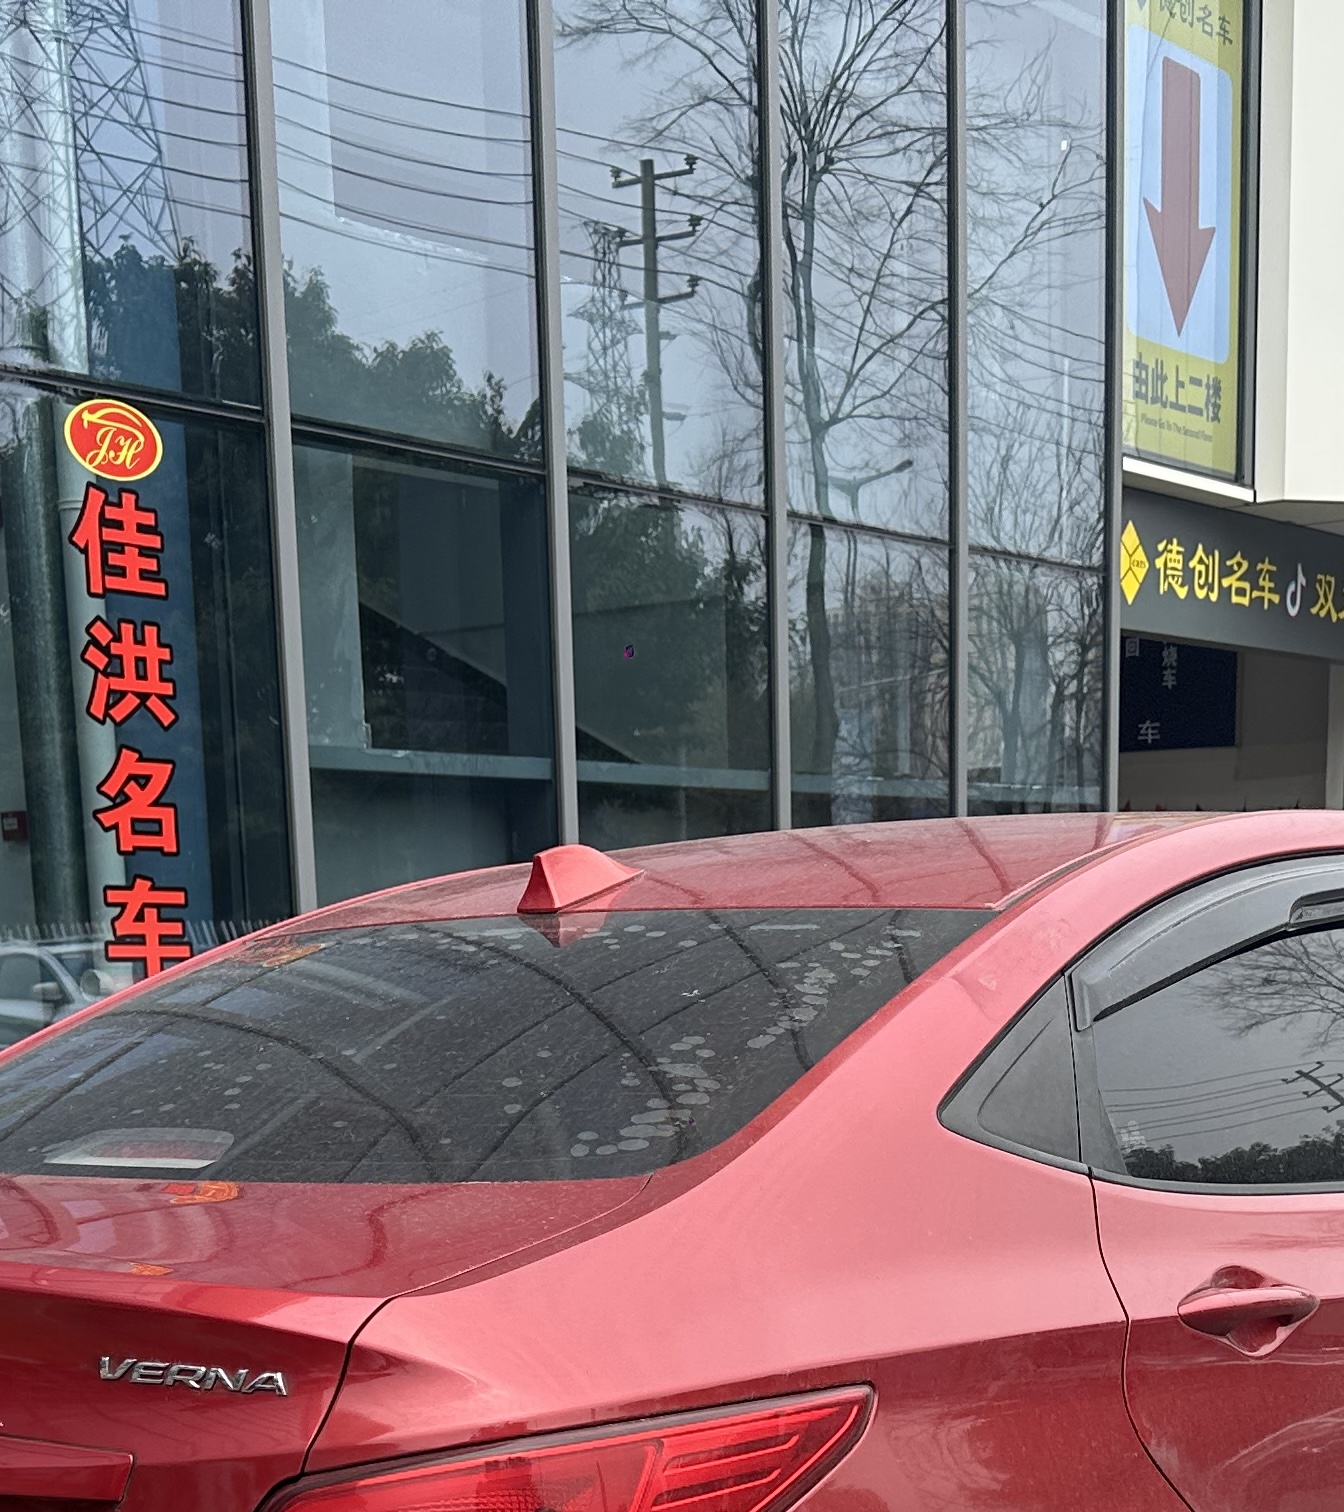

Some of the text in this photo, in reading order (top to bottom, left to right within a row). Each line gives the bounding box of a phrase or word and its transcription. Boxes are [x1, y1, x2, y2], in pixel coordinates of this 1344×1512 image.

[1133, 352, 1222, 424] 由此上二楼
[1154, 537, 1281, 611] 德创名车
[68, 482, 194, 979] 佳洪名车
[99, 1355, 289, 1397] VERNA
